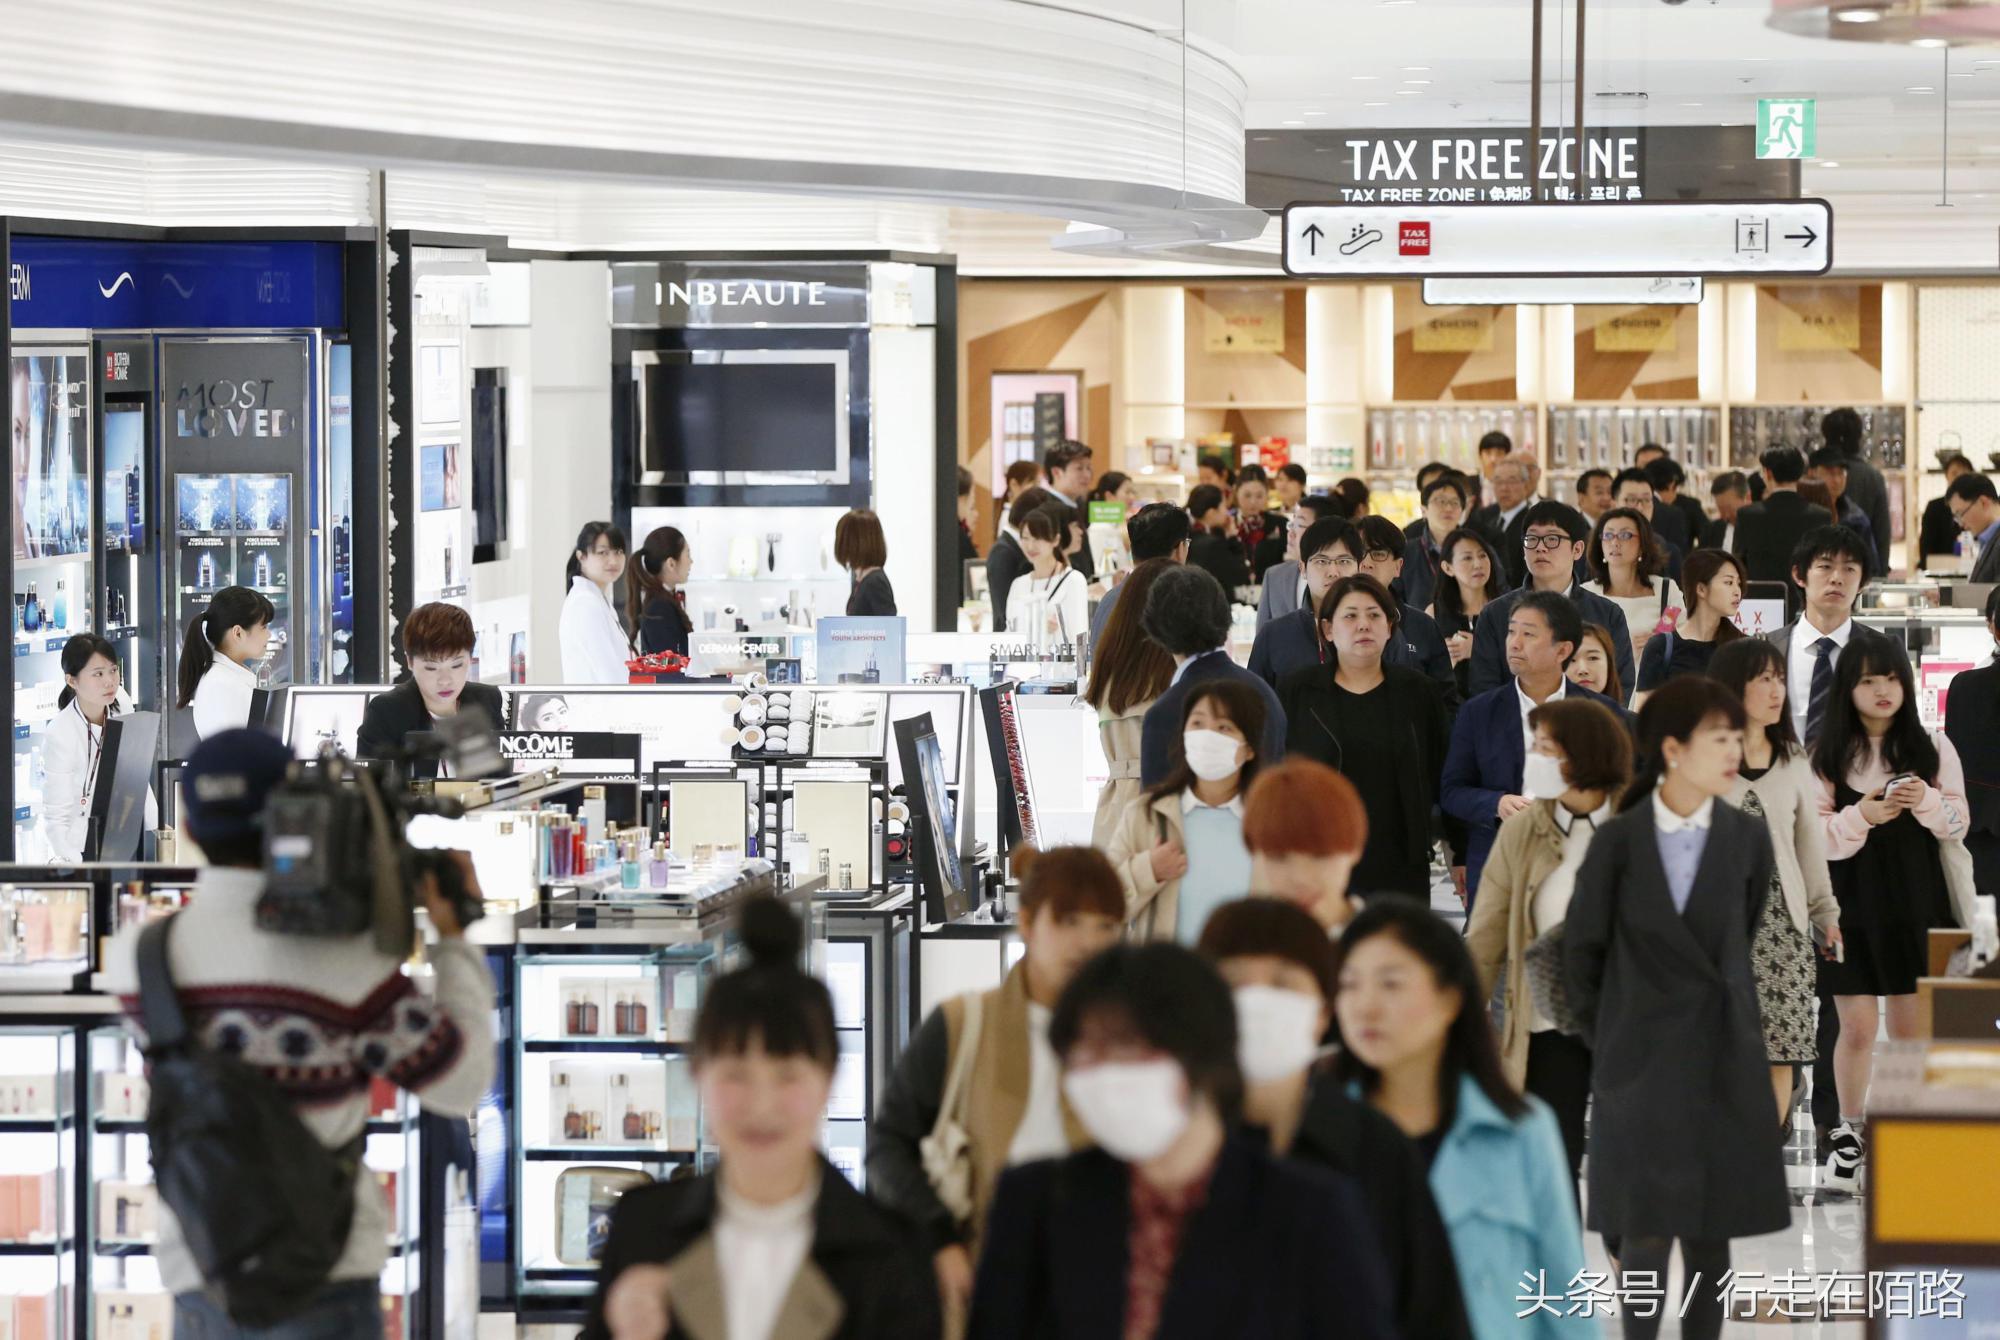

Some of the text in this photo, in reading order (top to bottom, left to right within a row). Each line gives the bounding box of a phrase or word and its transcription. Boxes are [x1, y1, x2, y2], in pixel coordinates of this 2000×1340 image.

[1345, 138, 1638, 181] TAX FREE ZONE
[1340, 187, 1476, 202] TAX FREE ZONE
[1590, 186, 1620, 201] 프리
[1403, 229, 1426, 238] TAX
[1400, 238, 1428, 247] FREE
[655, 281, 827, 306] INBEAUTE
[177, 380, 275, 409] MOST
[177, 408, 296, 438] LOVED
[276, 572, 287, 585] 2
[1734, 610, 1762, 625] AX
[278, 631, 287, 643] 3
[500, 733, 574, 753] NCÔME
